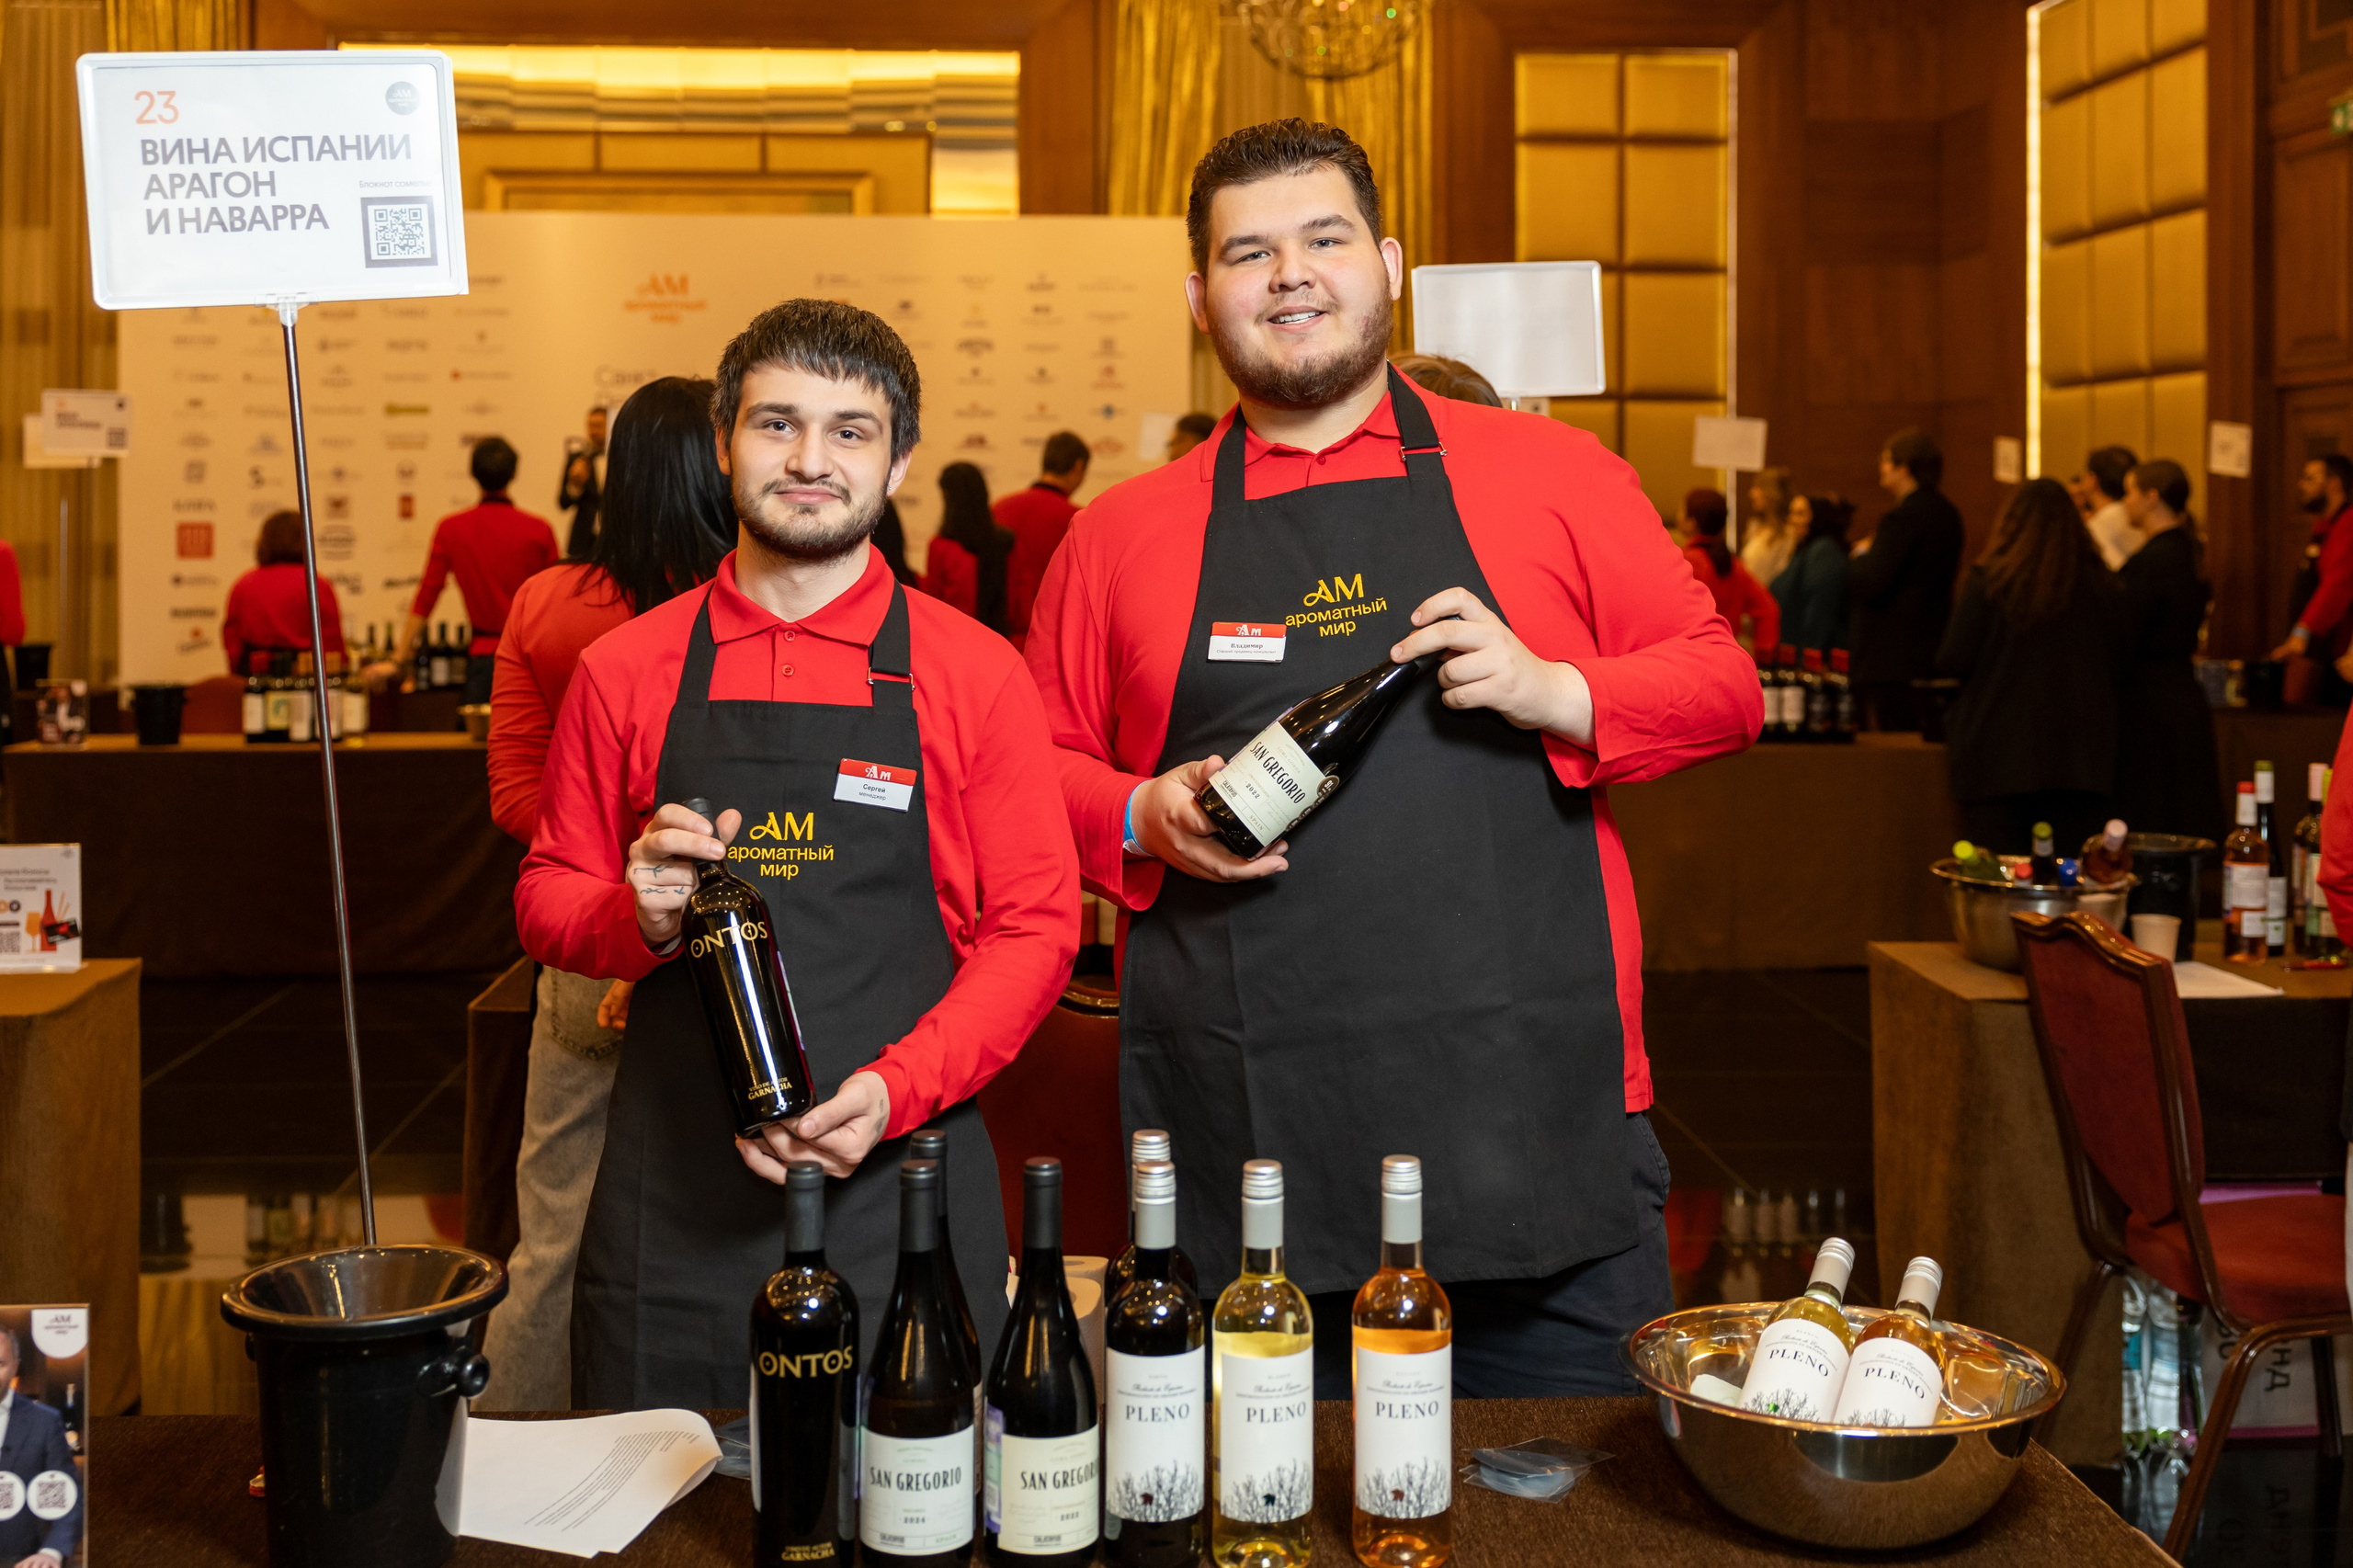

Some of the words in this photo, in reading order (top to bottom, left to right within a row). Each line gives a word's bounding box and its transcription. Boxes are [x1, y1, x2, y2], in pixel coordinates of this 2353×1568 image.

[135, 90, 179, 124] 23
[141, 137, 236, 165] ВИНА
[243, 134, 411, 163] ИСПАНИИ
[143, 170, 276, 200] АРАГОН
[145, 209, 170, 234] И
[179, 203, 330, 234] НАВАРРА
[1303, 574, 1365, 607] АМ
[1285, 597, 1388, 627] ароматный
[1319, 619, 1357, 638] мир
[1250, 741, 1269, 761] SAN
[1262, 756, 1306, 804] GREGORIO
[862, 783, 886, 793] Сергей
[1245, 783, 1260, 800] 2022
[749, 812, 814, 841] АМ
[727, 845, 835, 863] ароматный
[760, 864, 799, 880] мир
[690, 921, 768, 959] ONTOS
[758, 1346, 853, 1379] ONTOS
[1769, 1348, 1829, 1377] PLENO
[1864, 1368, 1925, 1399] PLENO
[1125, 1403, 1190, 1423] PLENO
[1246, 1401, 1307, 1423] PLENO
[1376, 1400, 1439, 1419] PLENO
[870, 1466, 892, 1489] SAN
[896, 1466, 962, 1492] GREGORIO
[1020, 1471, 1047, 1490] SAN
